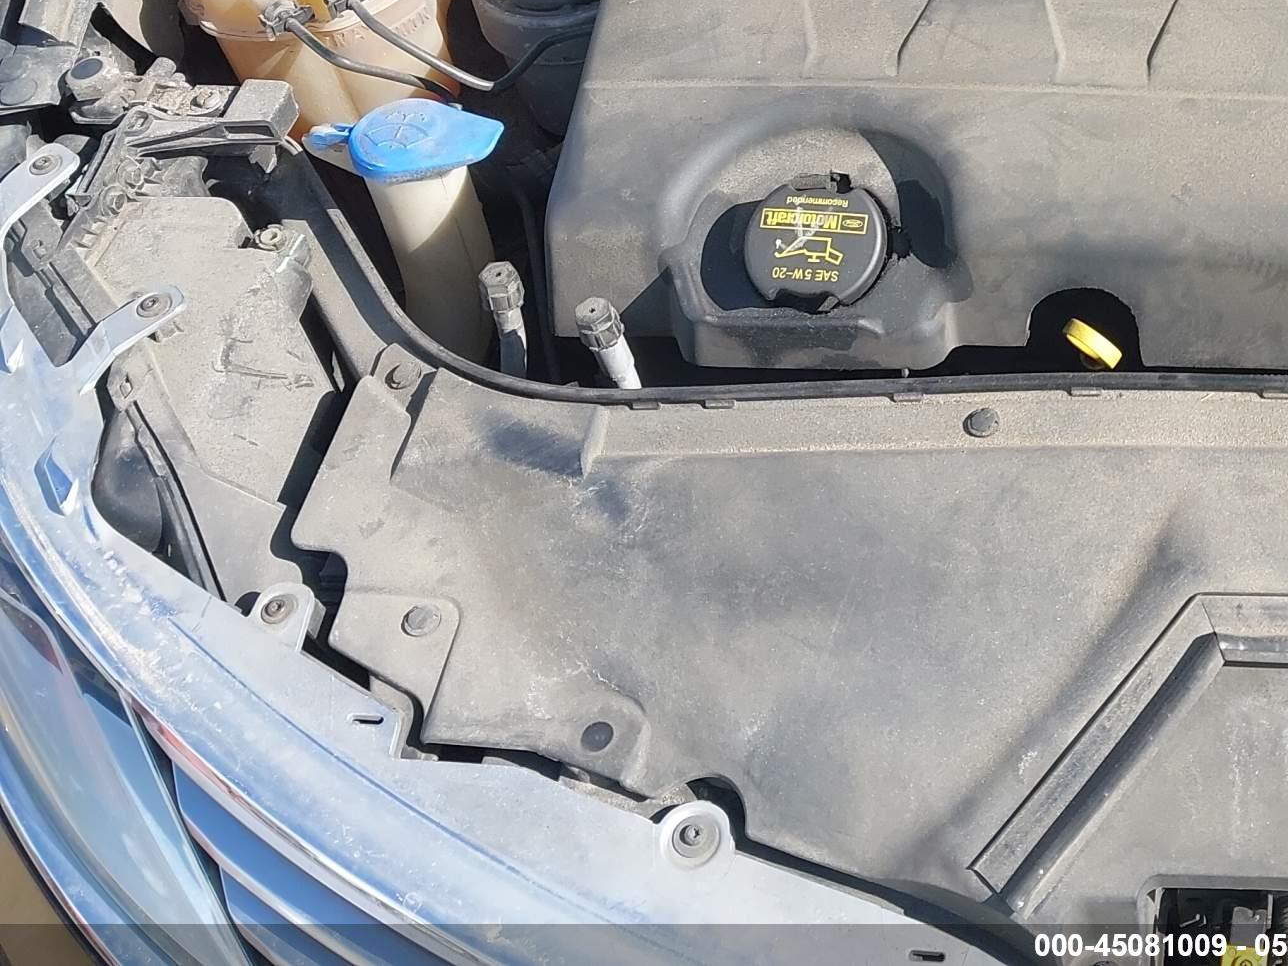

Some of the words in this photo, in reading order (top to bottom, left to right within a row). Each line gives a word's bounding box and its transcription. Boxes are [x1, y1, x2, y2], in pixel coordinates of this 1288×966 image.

[787, 195, 849, 207] Recommended
[766, 211, 838, 229] Motorcraft
[772, 267, 812, 281] 5W-20
[815, 270, 839, 282] SAE
